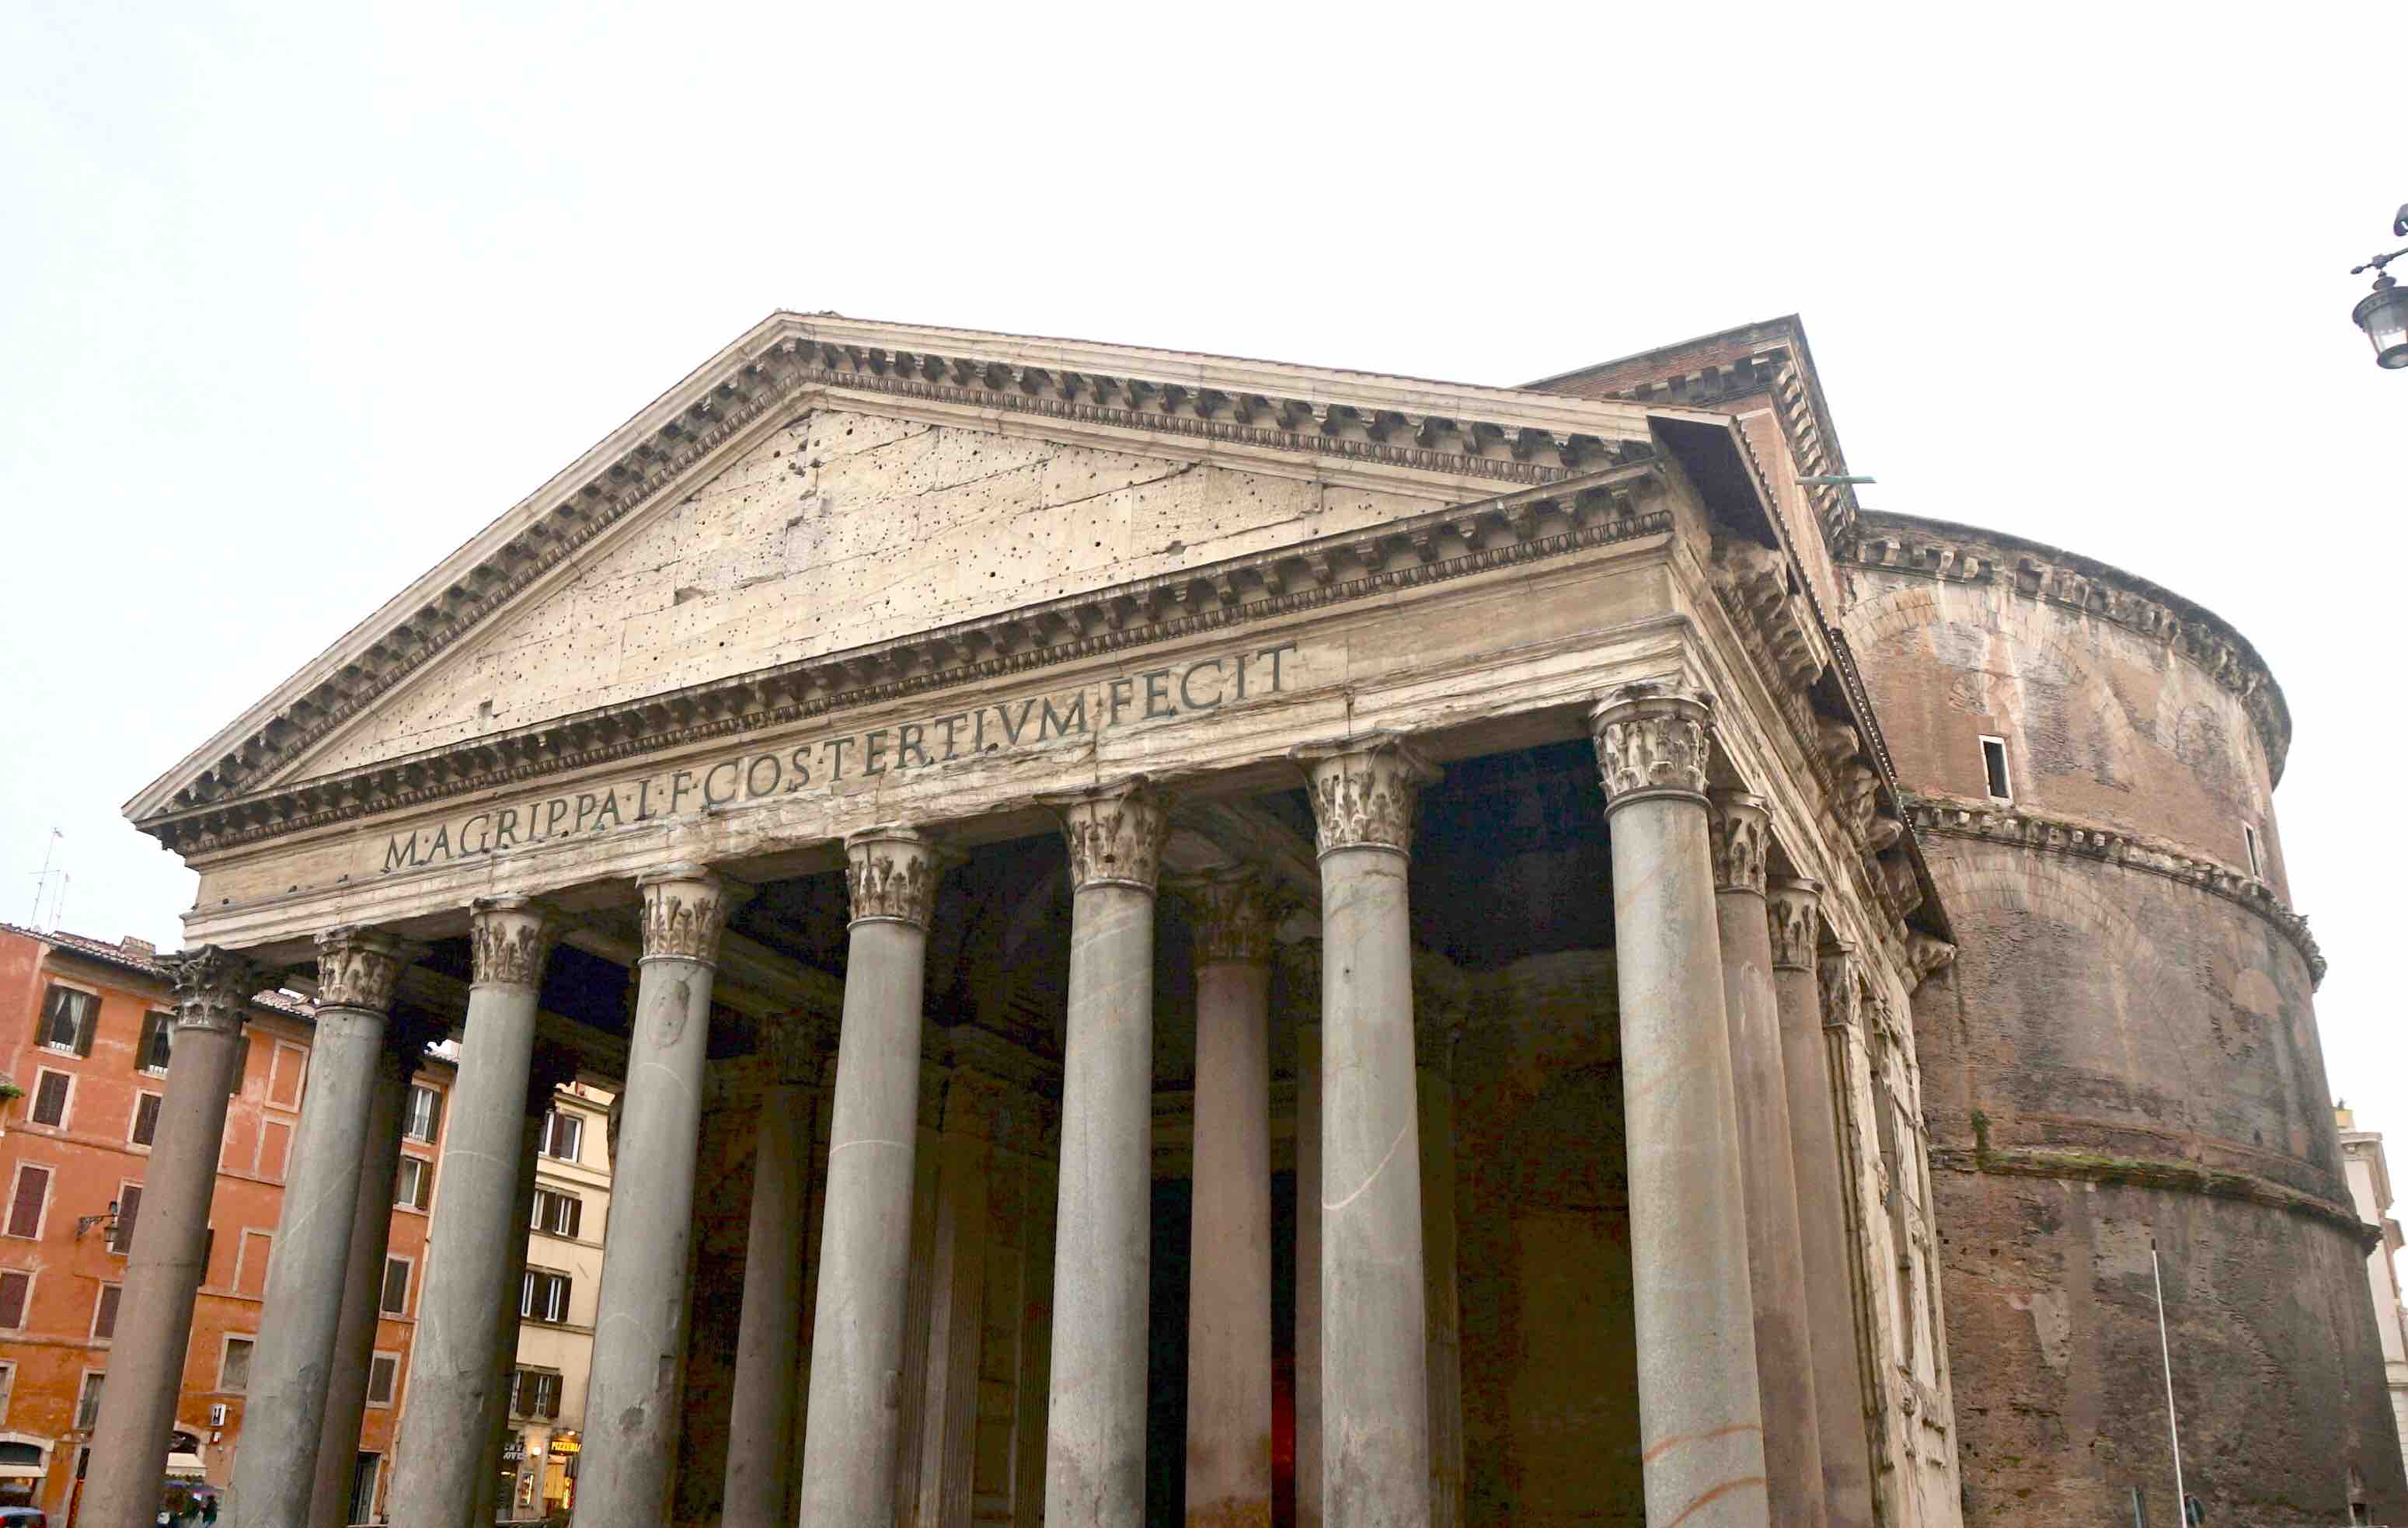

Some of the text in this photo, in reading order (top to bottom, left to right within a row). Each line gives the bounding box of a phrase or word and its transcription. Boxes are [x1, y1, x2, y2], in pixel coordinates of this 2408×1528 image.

[380, 829, 425, 873] M
[427, 788, 623, 860] AGRIPPA
[667, 771, 692, 814] F
[704, 746, 811, 806] COS
[823, 689, 1089, 781] TERTIVM
[1107, 639, 1298, 726] FECIT
